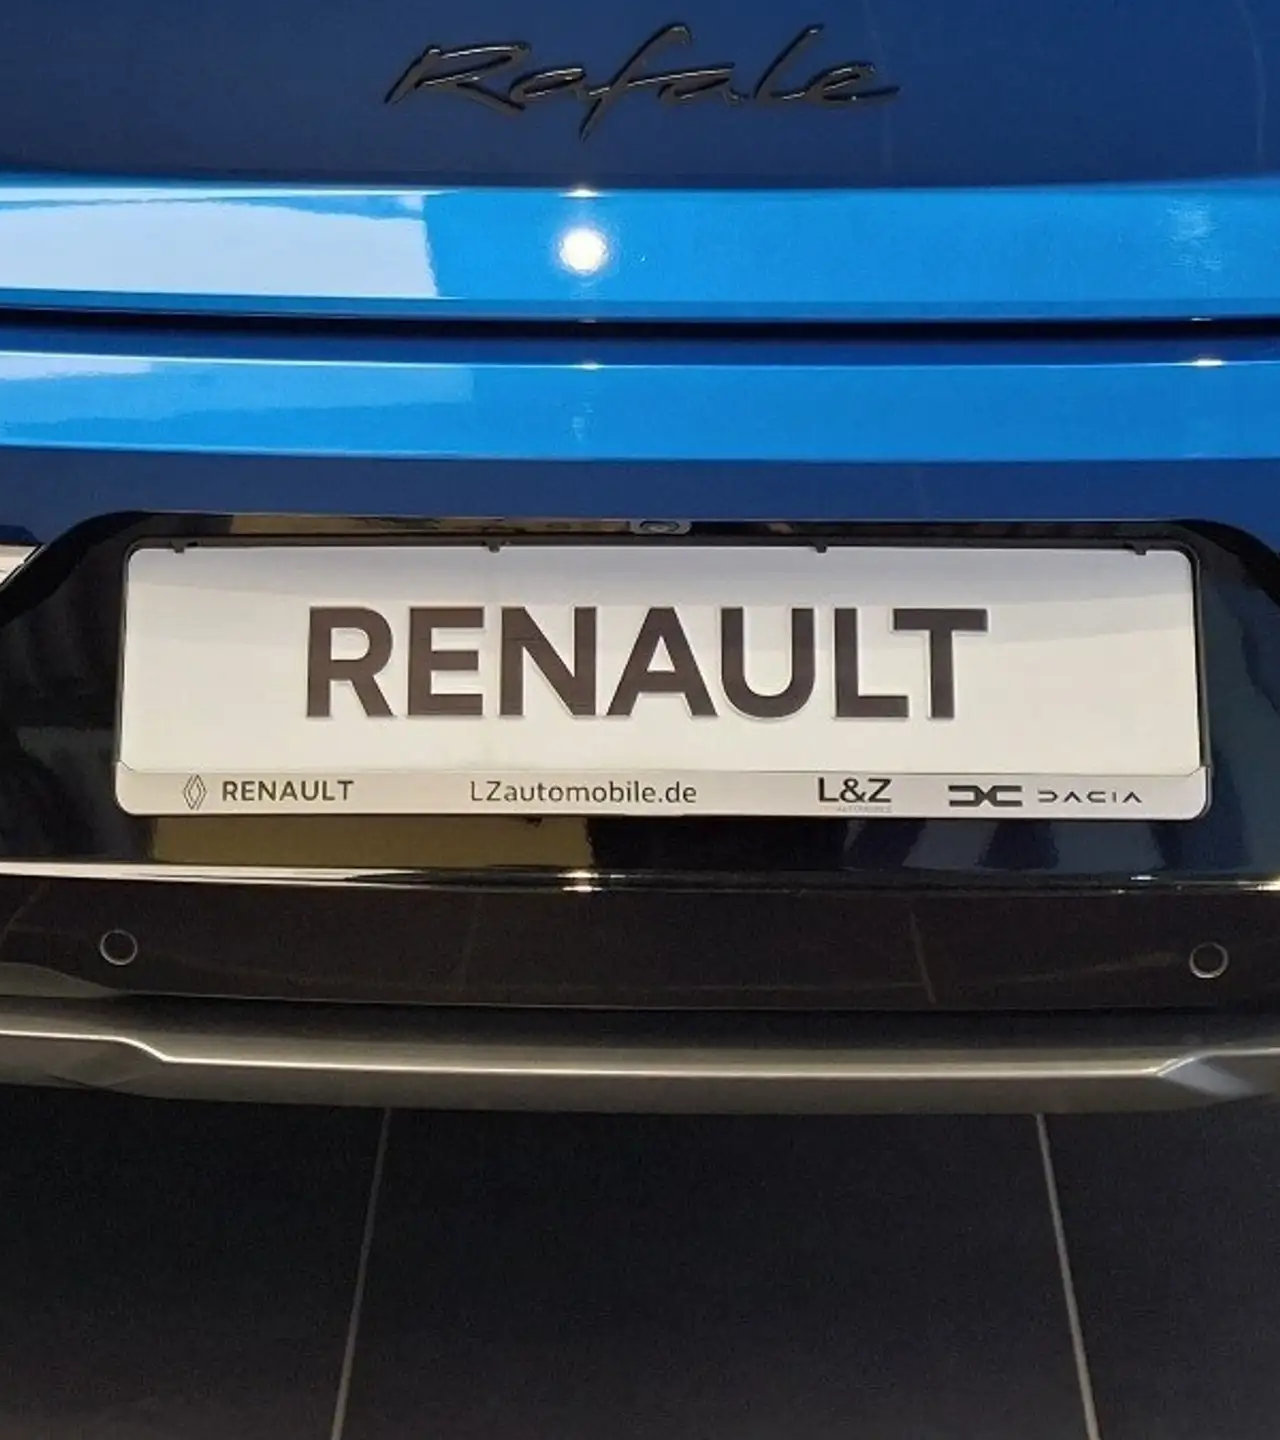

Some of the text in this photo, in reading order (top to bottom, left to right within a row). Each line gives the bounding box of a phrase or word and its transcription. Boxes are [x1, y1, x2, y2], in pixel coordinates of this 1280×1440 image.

[383, 21, 900, 142] Rafale
[305, 606, 989, 720] RENAULT
[222, 779, 355, 802] RENAULT
[470, 780, 698, 804] LZautomobile.de
[818, 776, 892, 803] L&Z
[1037, 790, 1143, 804] DACIA
